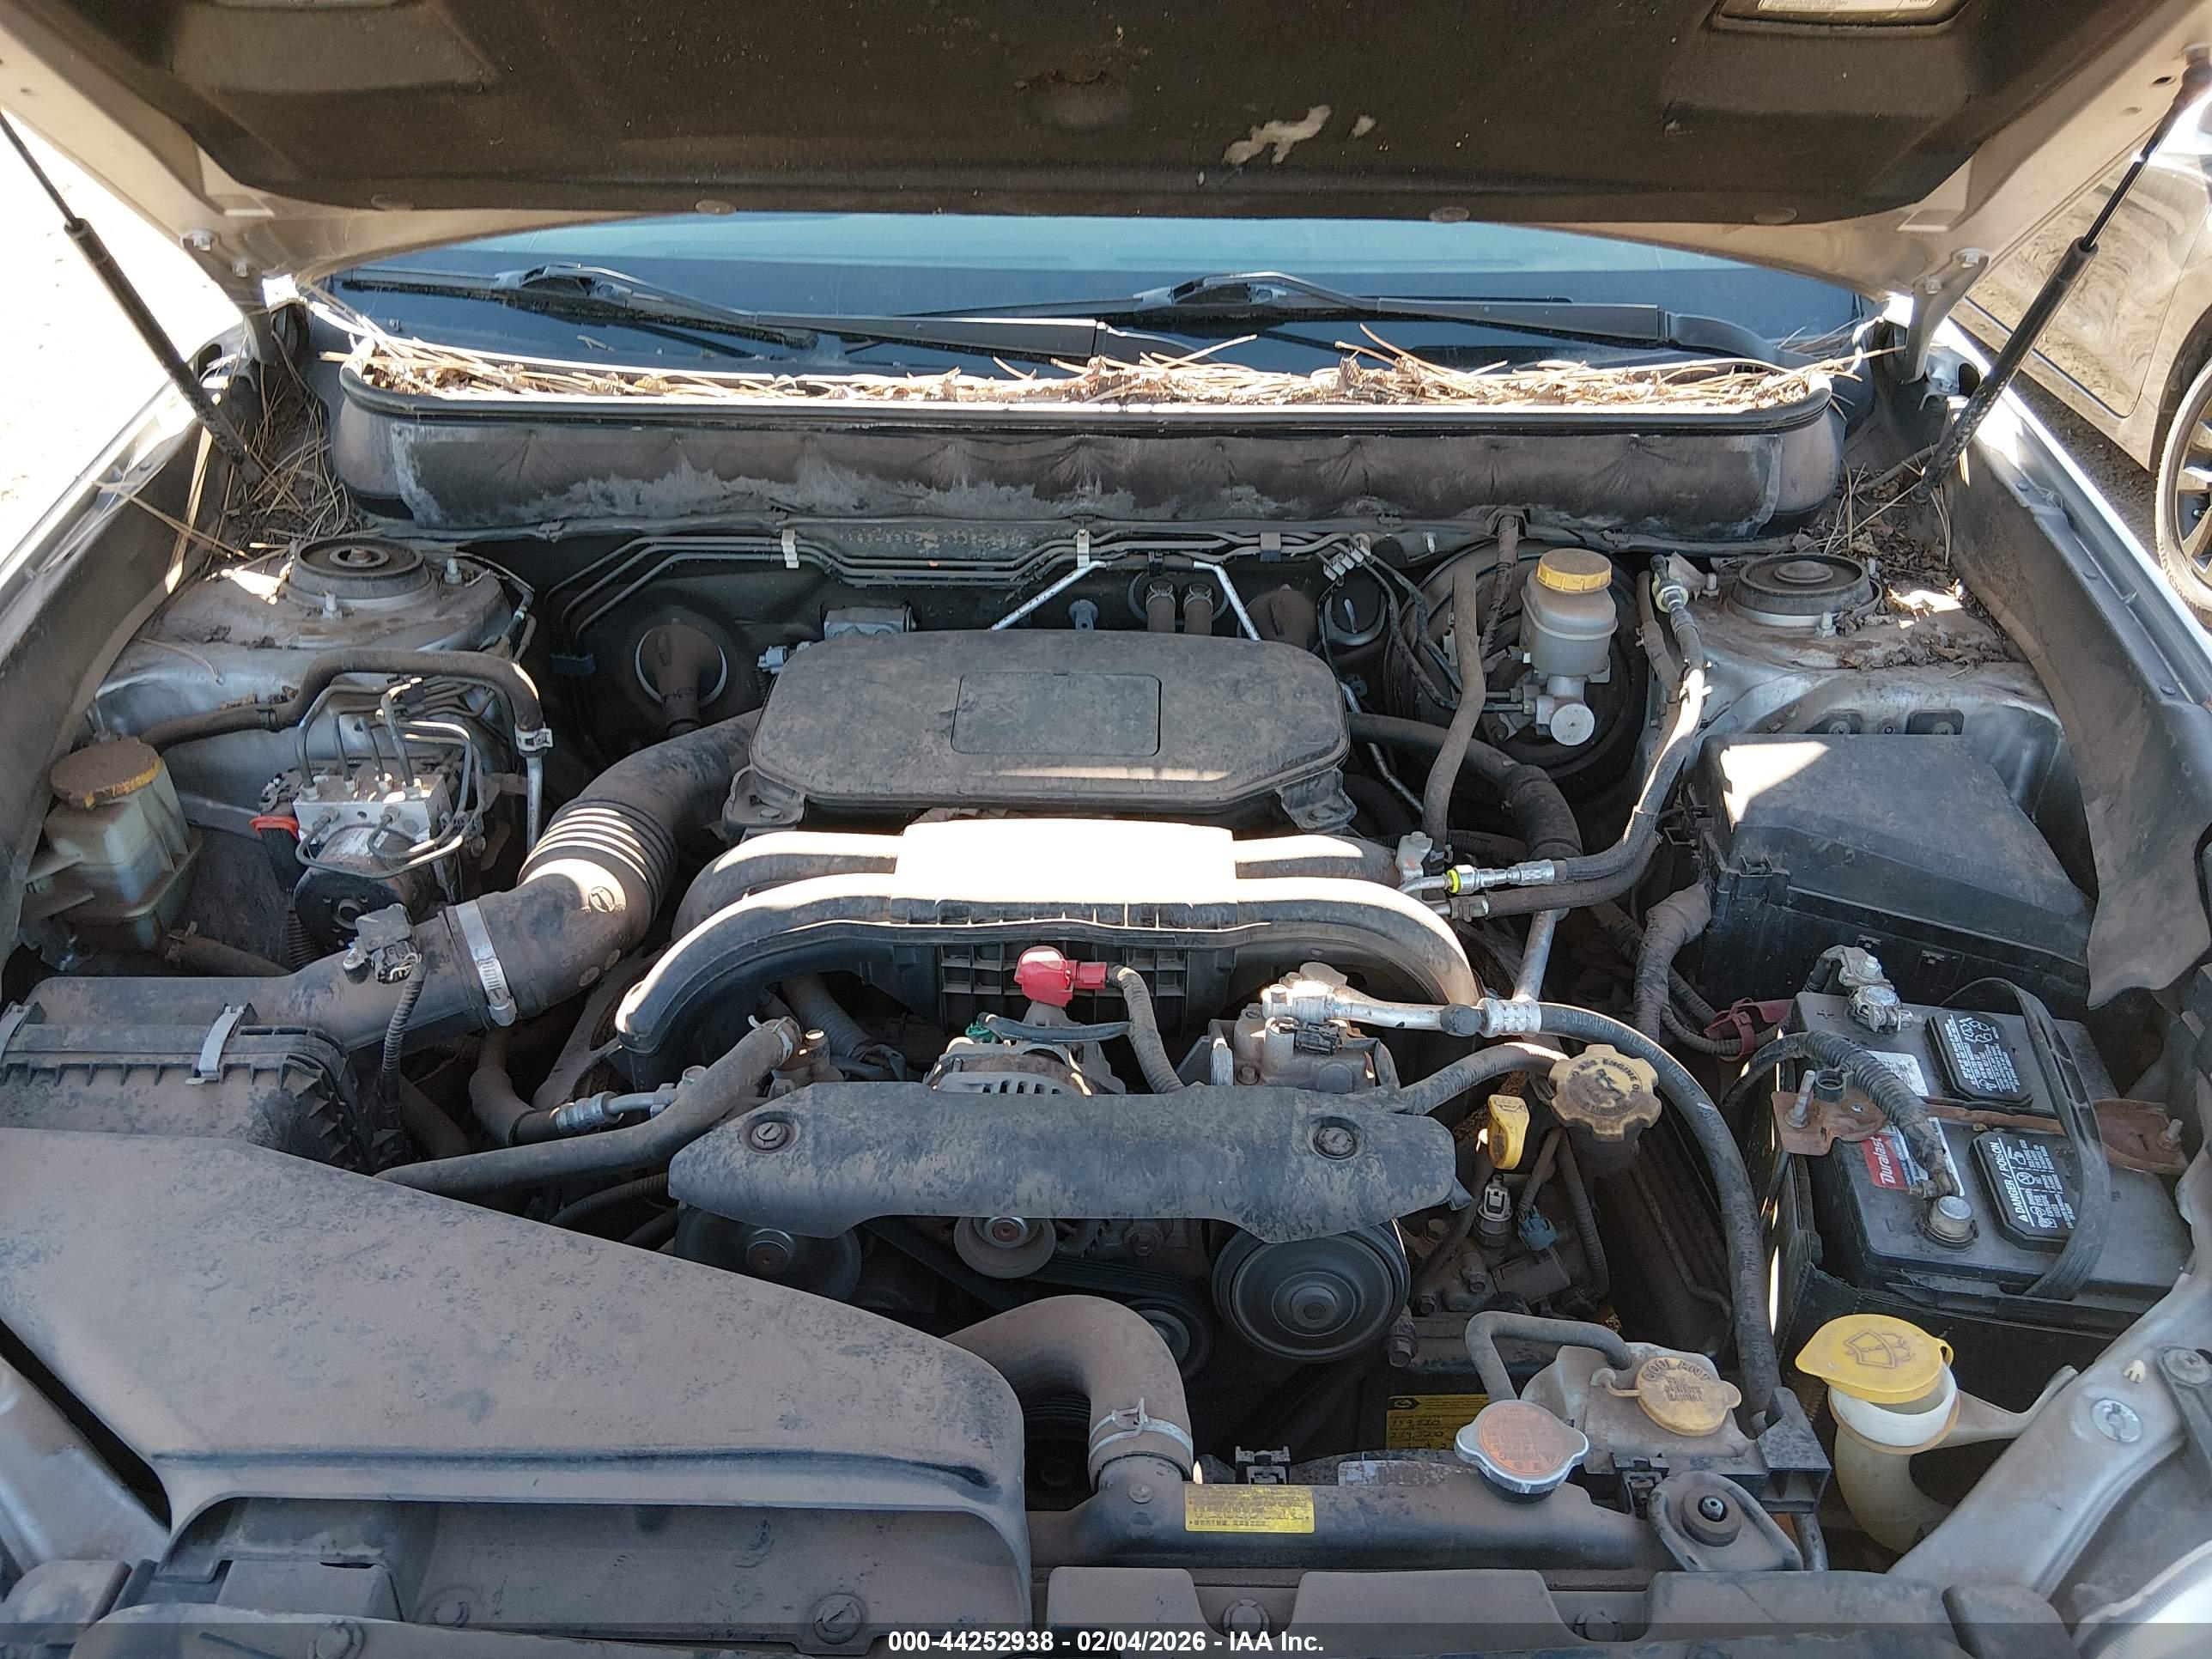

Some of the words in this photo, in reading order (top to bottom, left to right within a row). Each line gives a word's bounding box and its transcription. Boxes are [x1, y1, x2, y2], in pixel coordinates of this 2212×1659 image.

[1602, 1059, 1638, 1081] ENGINE
[1869, 1136, 1896, 1184] Duralast
[1990, 1142, 2009, 1171] POISON
[2004, 1179, 2027, 1213] DANGER
